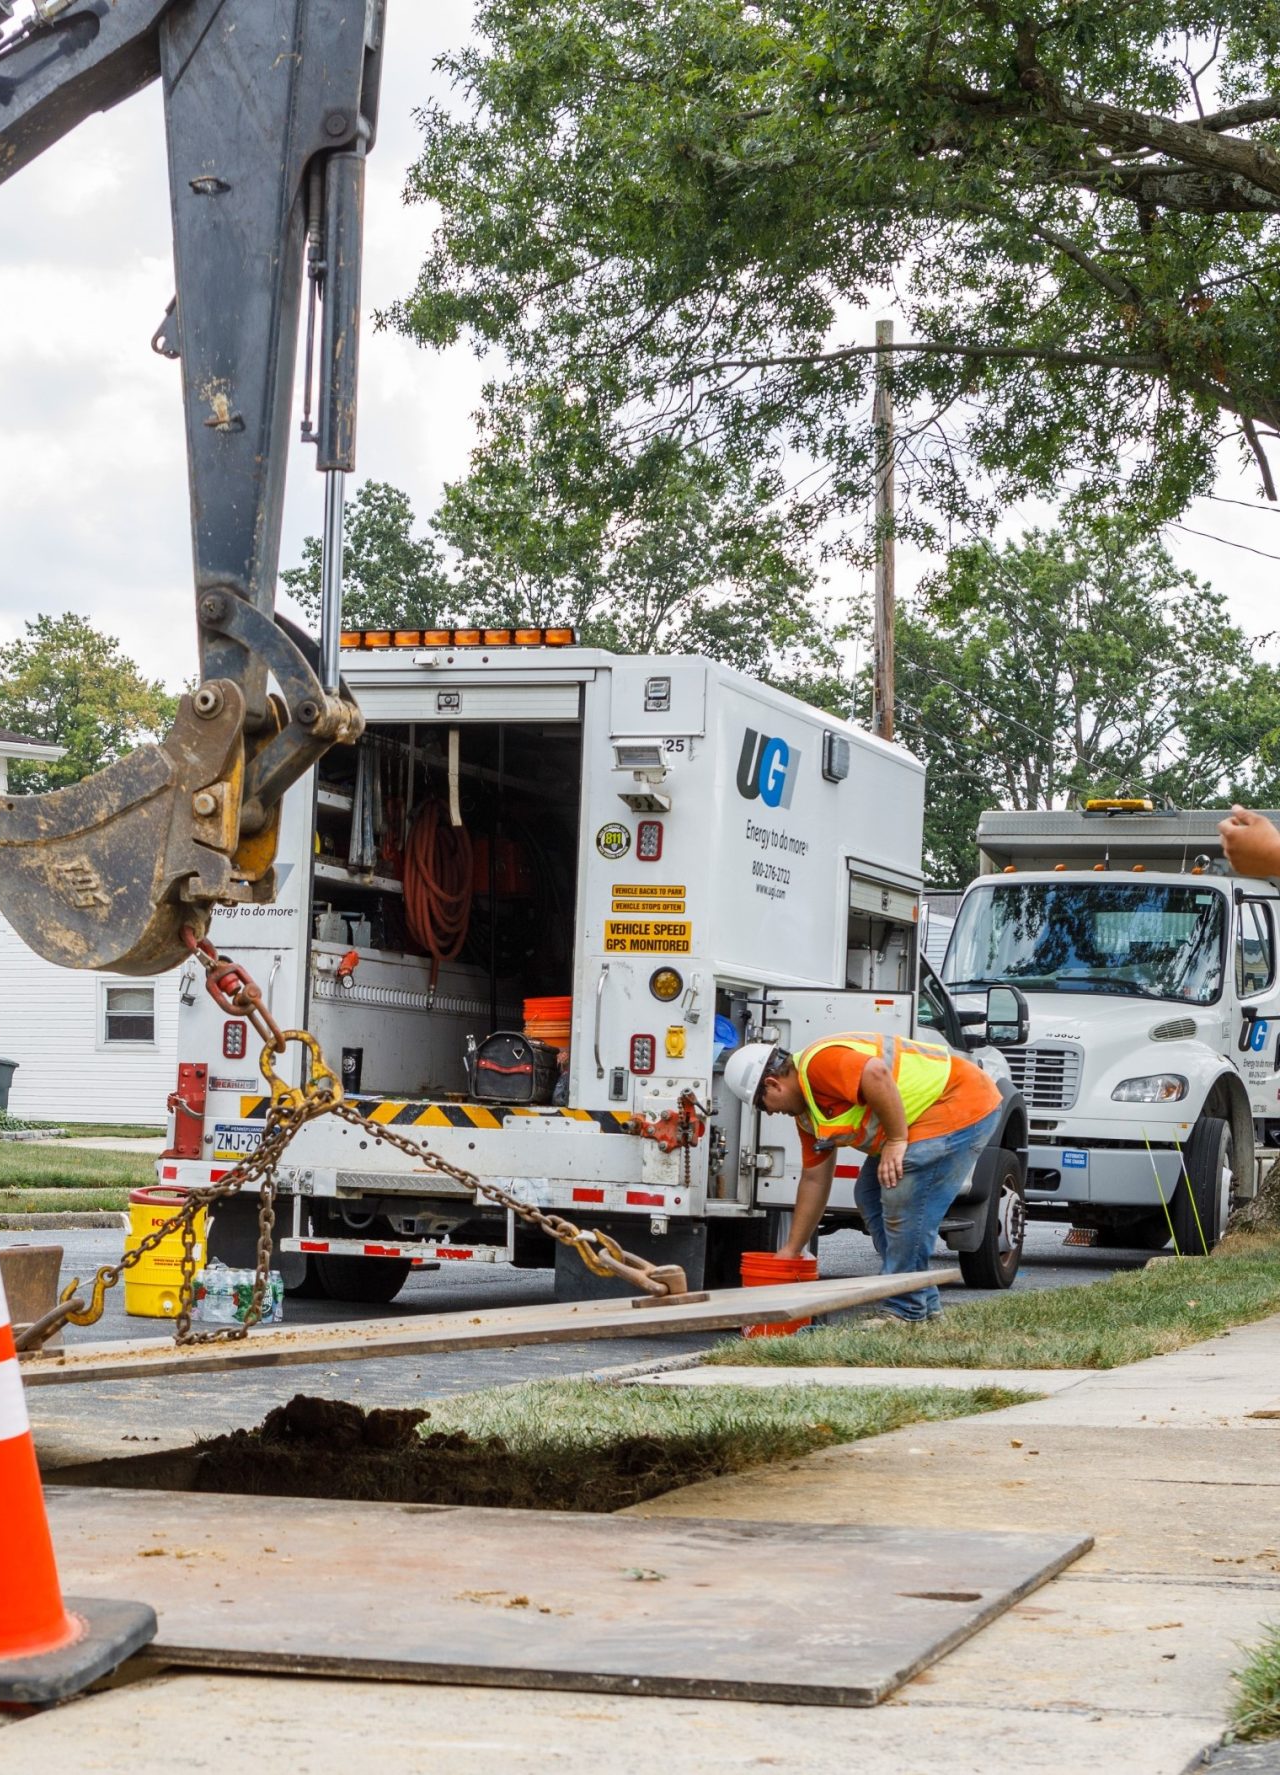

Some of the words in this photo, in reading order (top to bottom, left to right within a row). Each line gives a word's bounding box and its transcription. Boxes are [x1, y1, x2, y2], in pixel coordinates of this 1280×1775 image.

[663, 739, 685, 752] 25
[604, 831, 623, 845] 811
[746, 819, 771, 850] Energy
[771, 829, 779, 847] to
[779, 829, 788, 850] do
[752, 860, 791, 885] 800-276-2722
[615, 887, 637, 895] VEHICLE
[668, 888, 683, 896] PARK
[210, 907, 238, 918] nergy
[240, 907, 250, 916] to
[252, 906, 265, 916] do
[662, 903, 682, 911] OFTEN
[610, 923, 650, 936] VEHICLE
[653, 924, 686, 936] SPEED
[606, 938, 627, 950] GPS
[630, 939, 689, 952] MONITORED
